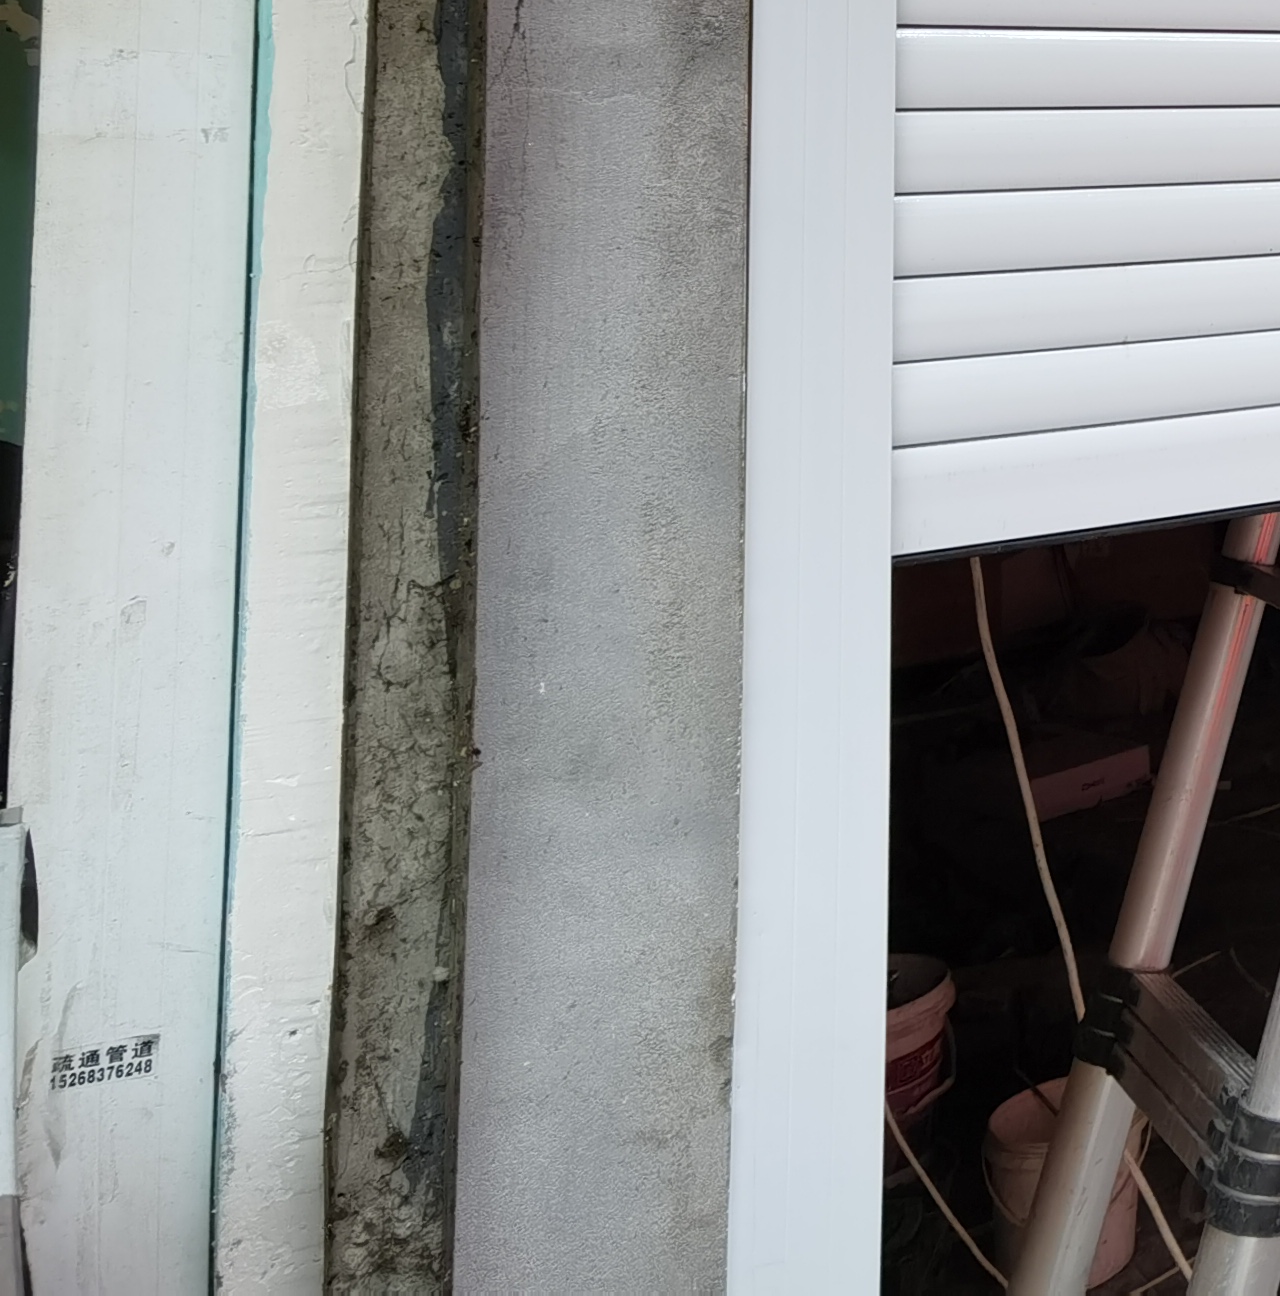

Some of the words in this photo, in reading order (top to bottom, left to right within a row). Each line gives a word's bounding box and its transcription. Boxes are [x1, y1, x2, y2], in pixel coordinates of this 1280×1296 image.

[50, 1039, 155, 1074] 疏通管道
[49, 1058, 153, 1091] 15268376248
